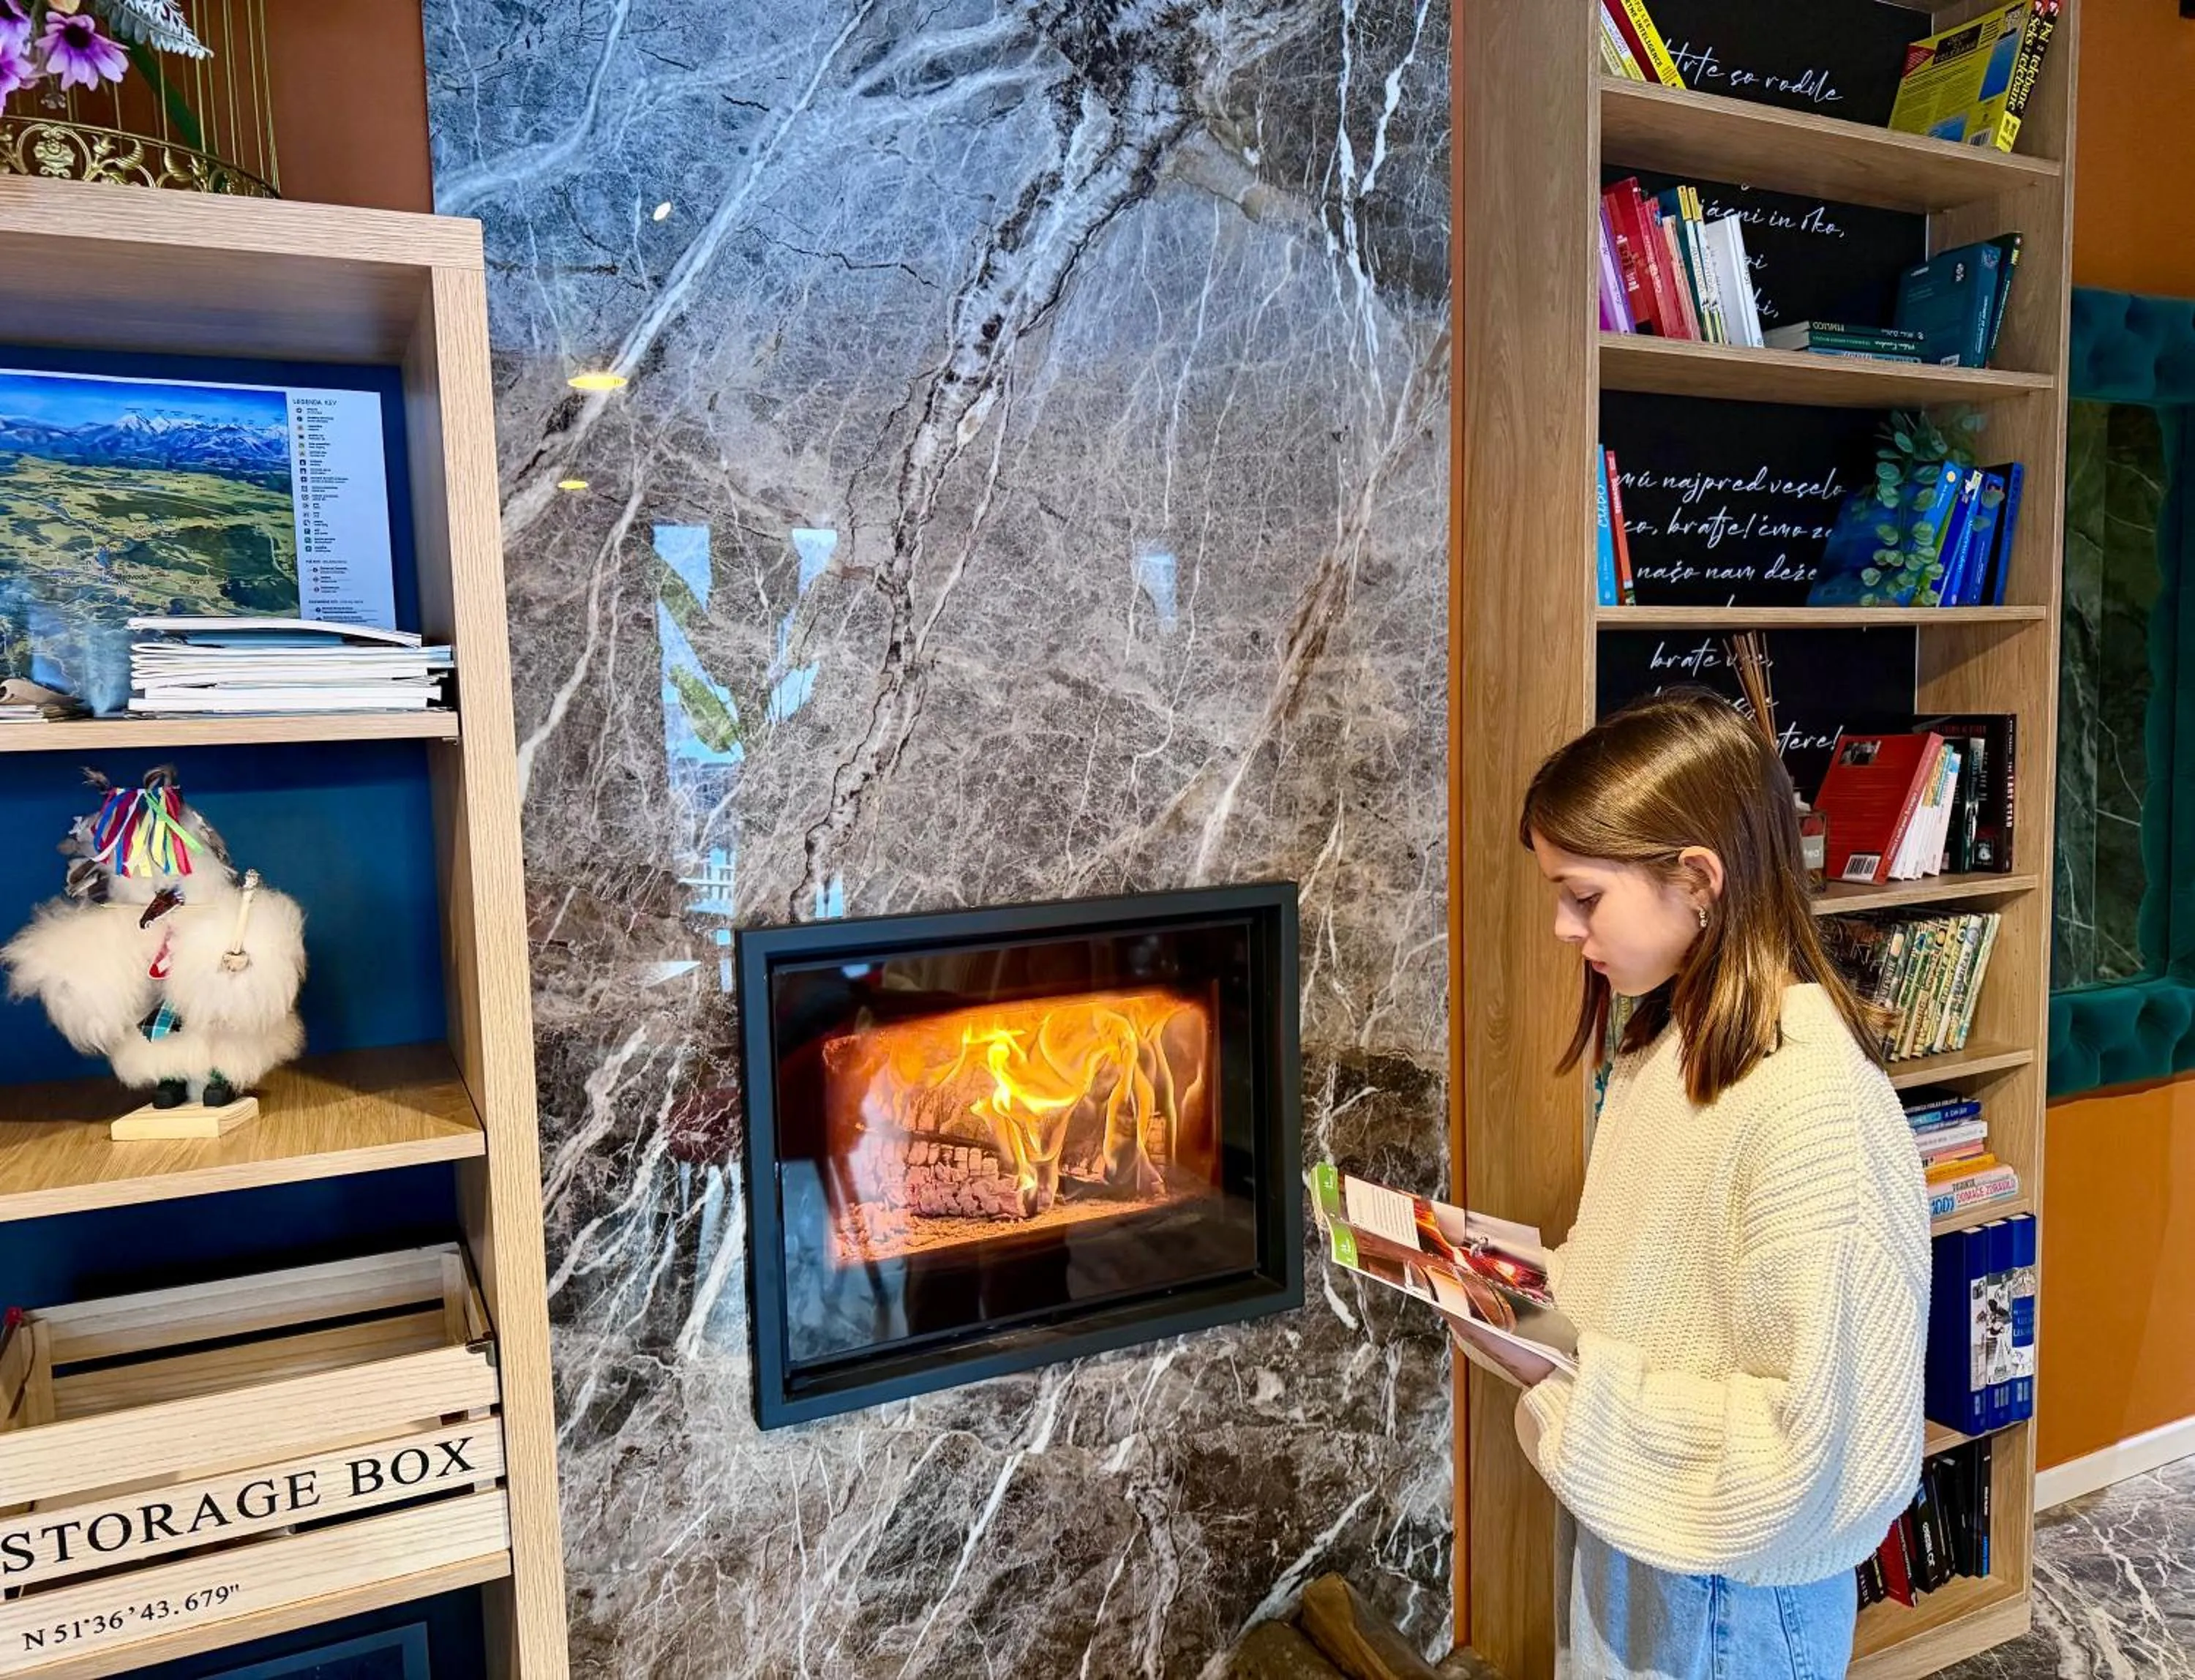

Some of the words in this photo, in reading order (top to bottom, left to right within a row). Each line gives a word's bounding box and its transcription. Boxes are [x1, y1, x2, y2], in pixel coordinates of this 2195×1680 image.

[1730, 69, 1759, 86] so
[1706, 564, 1756, 580] nam
[1764, 553, 1818, 582] deže
[0, 1470, 321, 1575] STORAGE
[346, 1436, 476, 1498] BOX
[23, 1629, 45, 1651] N
